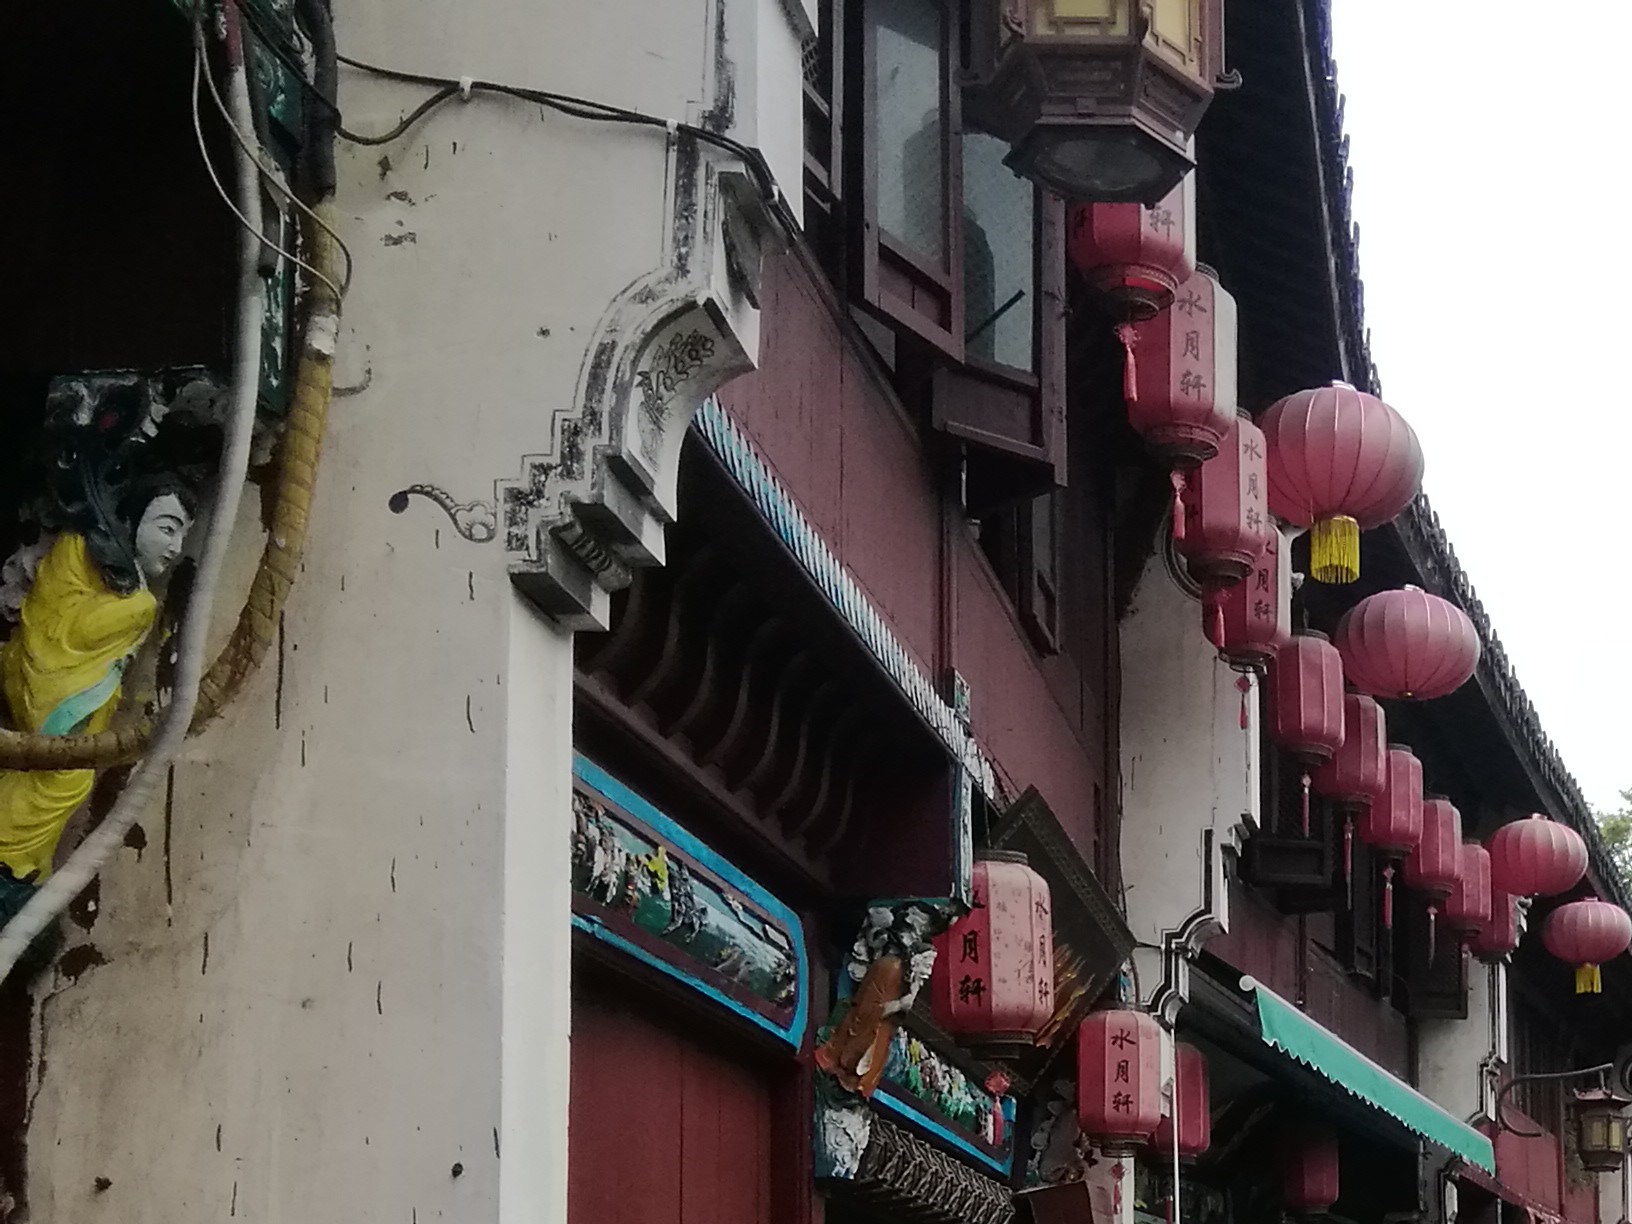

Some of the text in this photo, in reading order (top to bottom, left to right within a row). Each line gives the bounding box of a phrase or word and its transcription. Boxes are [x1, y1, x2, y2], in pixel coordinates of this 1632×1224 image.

[1178, 289, 1208, 400] 水月轩
[1242, 437, 1263, 536] 水月轩
[1110, 1028, 1137, 1115] 水月轩
